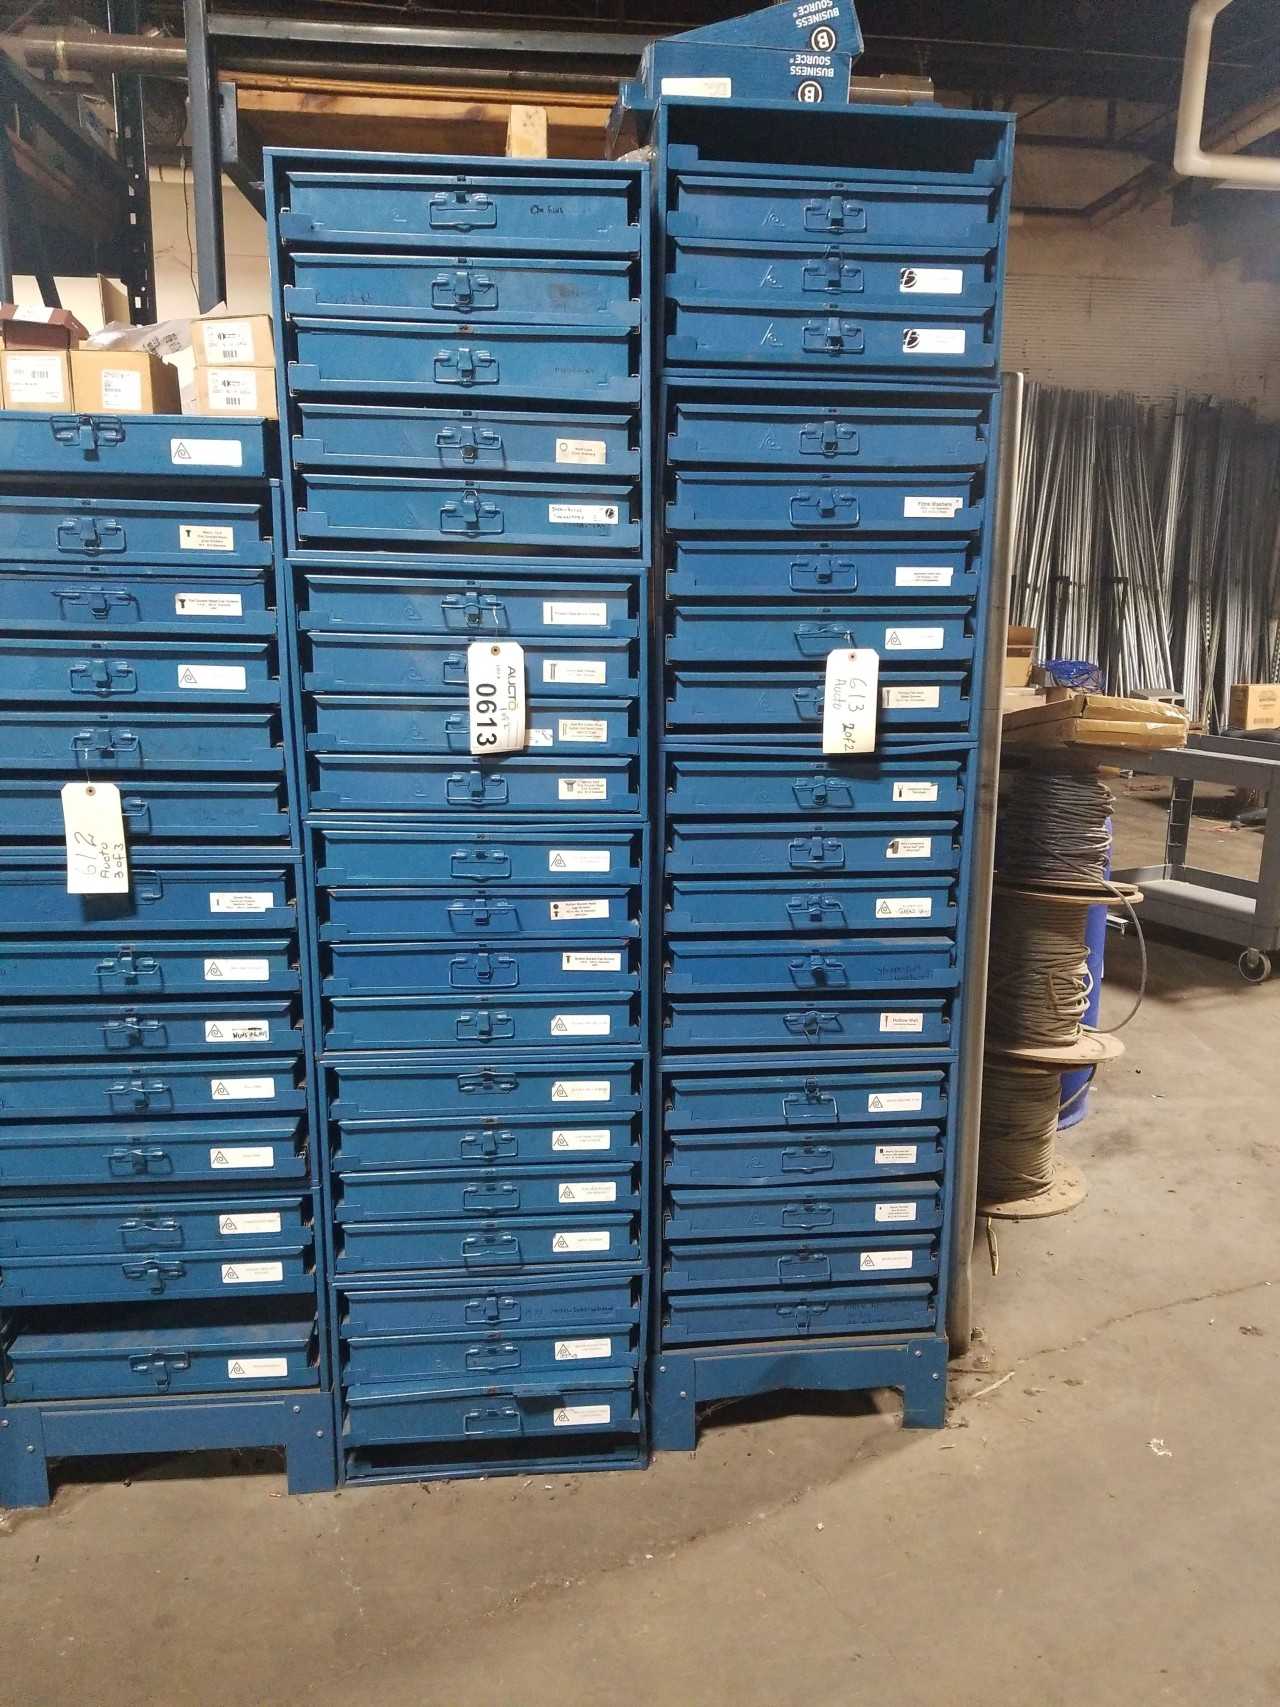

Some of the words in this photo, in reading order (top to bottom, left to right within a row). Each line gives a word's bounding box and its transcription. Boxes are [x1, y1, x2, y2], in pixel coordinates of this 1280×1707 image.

[795, 7, 840, 28] BUSINESS
[789, 66, 834, 77] BUSINESS
[848, 678, 868, 713] 613
[475, 683, 498, 746] 0613
[73, 831, 97, 876] 612
